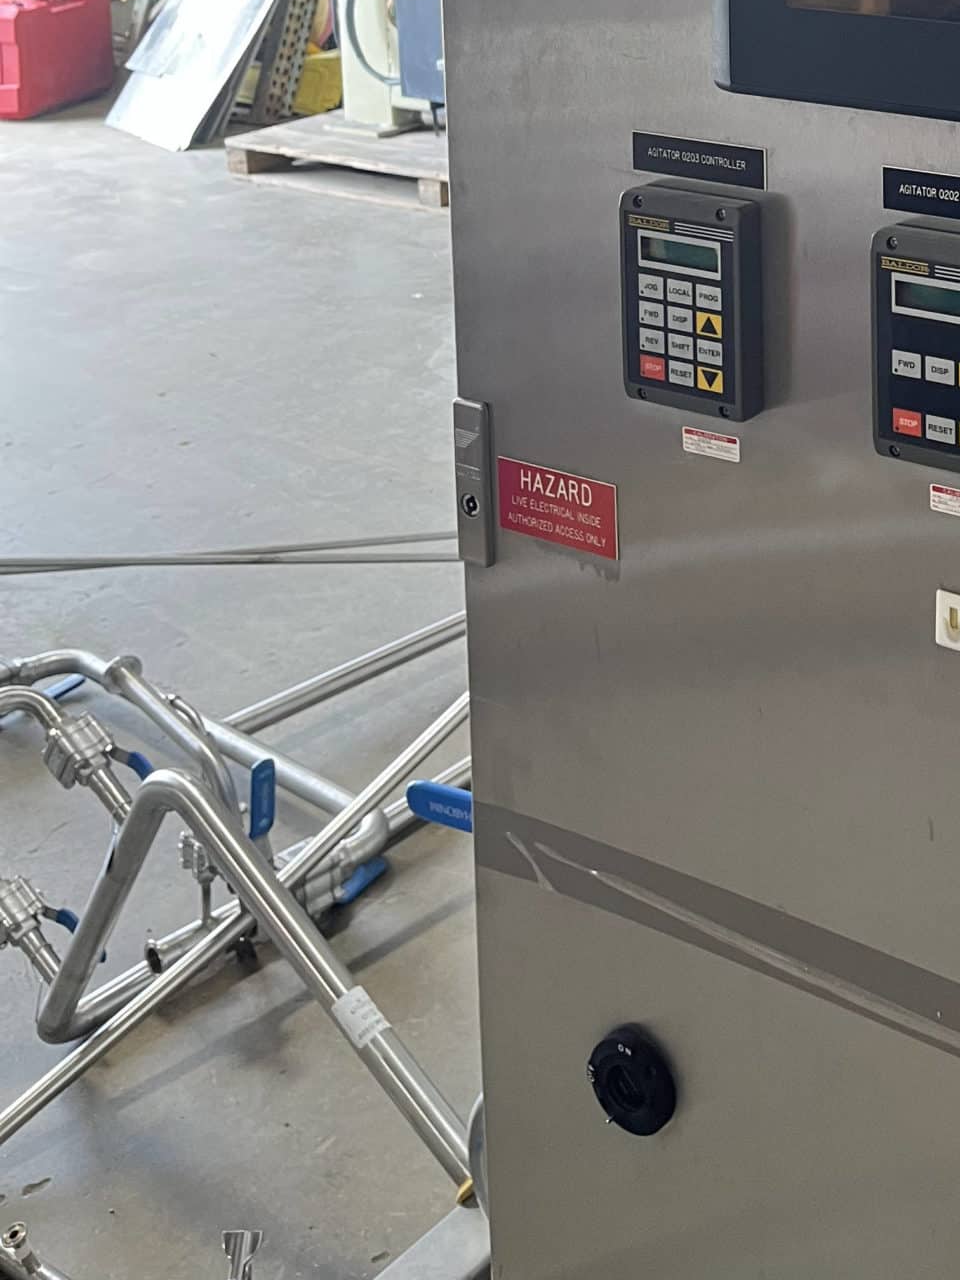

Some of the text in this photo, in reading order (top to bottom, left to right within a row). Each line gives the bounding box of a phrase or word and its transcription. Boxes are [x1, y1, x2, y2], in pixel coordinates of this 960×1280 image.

[647, 147, 746, 170] AGITATOR 0203 CONTROLLER
[899, 184, 937, 198] AGITATOR
[938, 190, 960, 202] 0202
[644, 283, 658, 291] JOG
[668, 287, 691, 297] LOCAL
[698, 293, 719, 302] PROG
[644, 309, 659, 318] FWD
[645, 336, 659, 345] REV
[698, 347, 721, 357] ENTER
[898, 359, 916, 369] FWD
[670, 368, 692, 378] RESET
[931, 365, 949, 375] DISP
[898, 418, 918, 428] STOP
[928, 423, 953, 435] RESET
[519, 468, 592, 507] HAZARD
[511, 495, 601, 528] LIVE ELECTRICAL INSIDE
[508, 511, 606, 548] AUTHORIZED ACCESS ONLY
